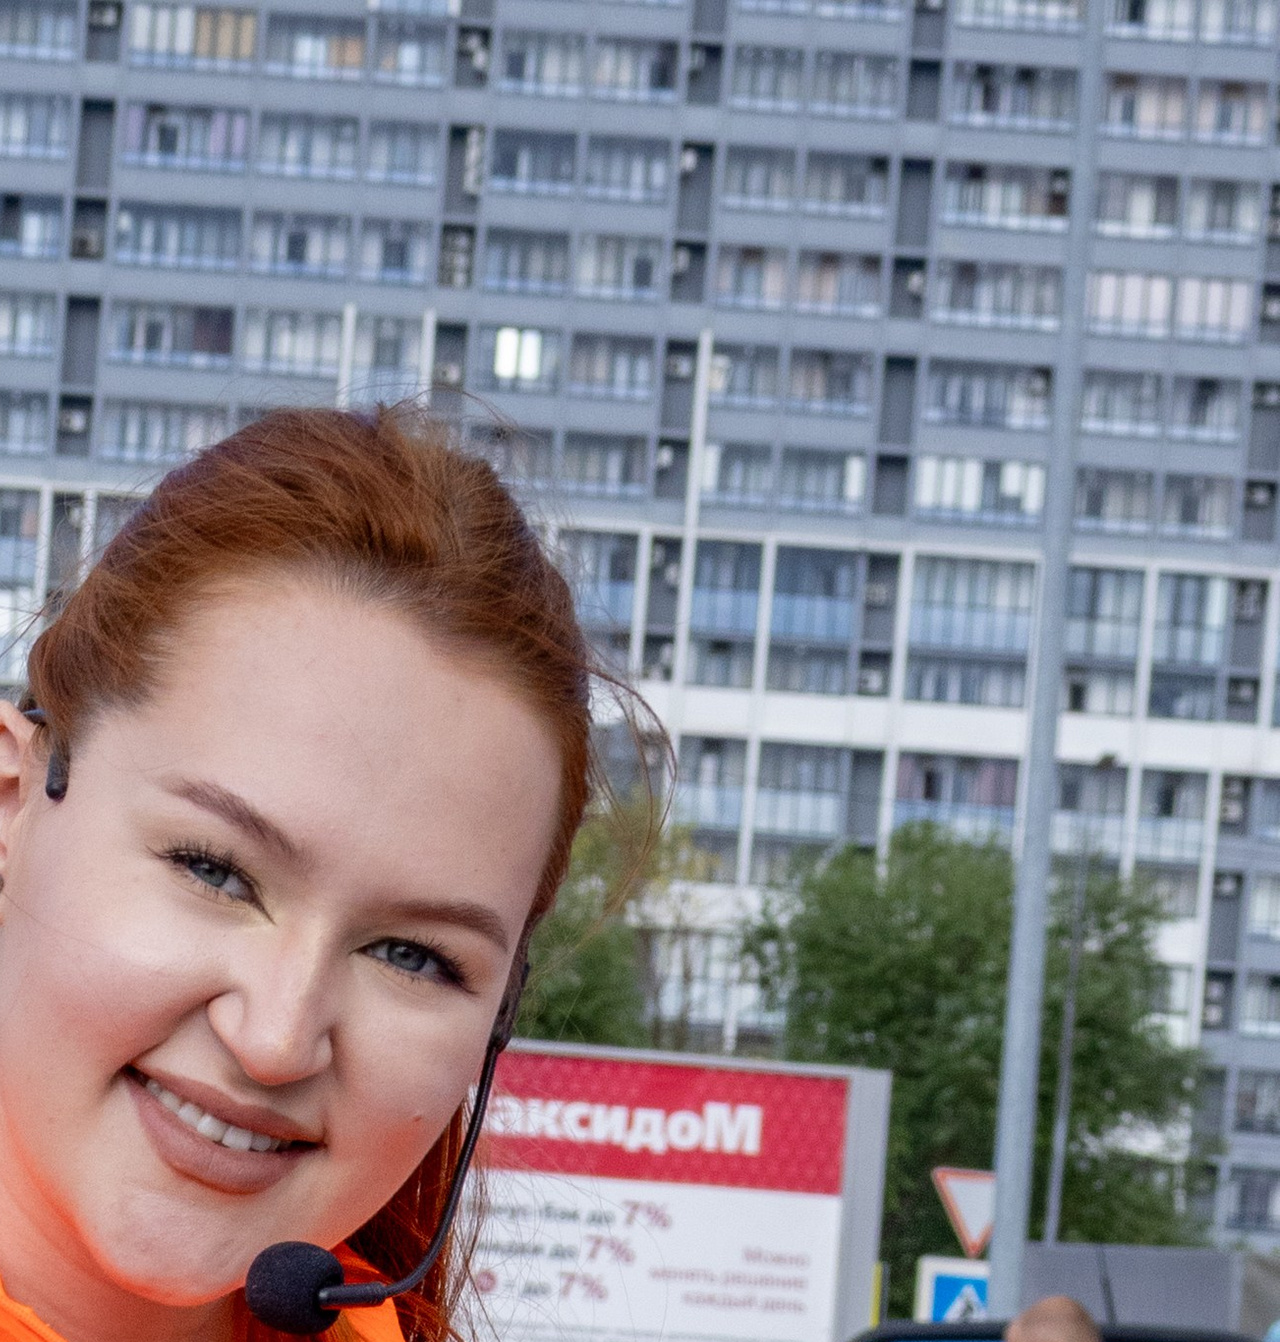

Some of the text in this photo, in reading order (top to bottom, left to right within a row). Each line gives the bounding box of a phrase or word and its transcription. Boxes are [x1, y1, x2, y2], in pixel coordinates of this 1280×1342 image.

[469, 1086, 762, 1155] аксидоМ
[623, 1199, 672, 1230] 7%
[584, 1233, 635, 1266] 7%
[559, 1271, 608, 1302] 7%
